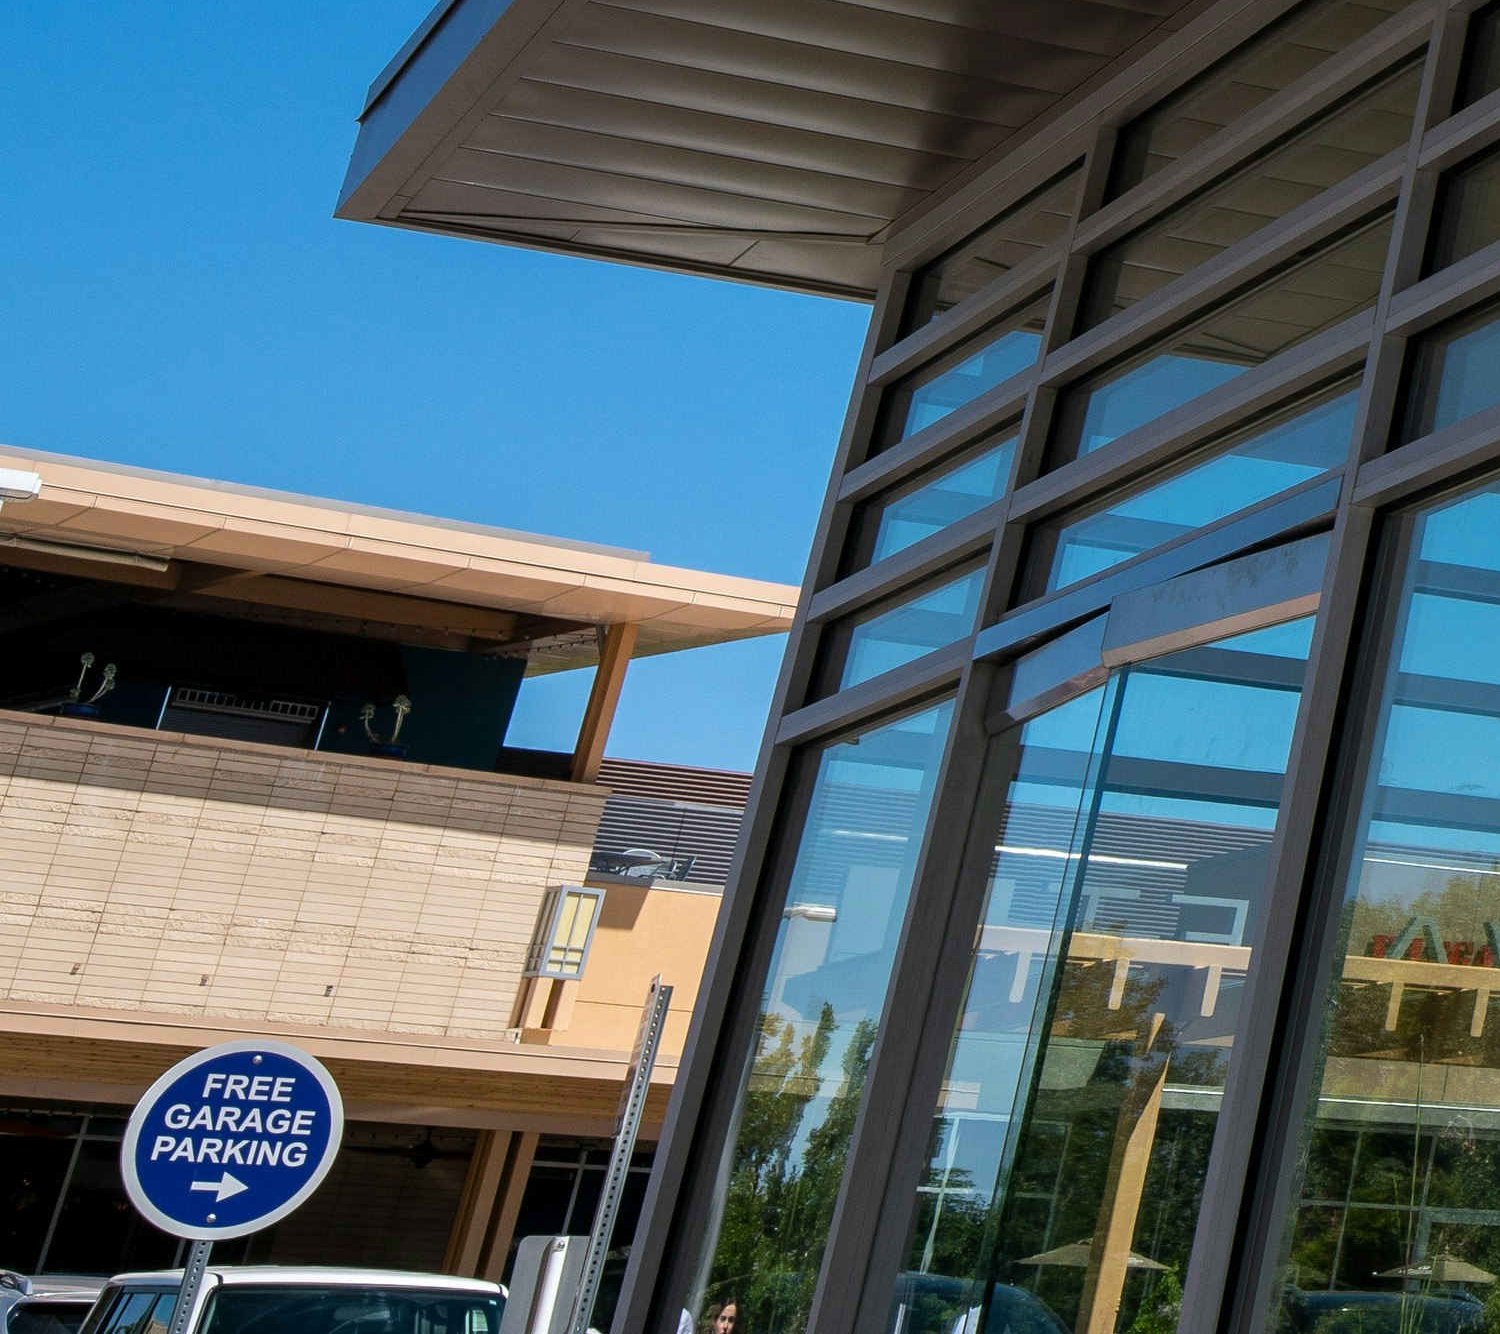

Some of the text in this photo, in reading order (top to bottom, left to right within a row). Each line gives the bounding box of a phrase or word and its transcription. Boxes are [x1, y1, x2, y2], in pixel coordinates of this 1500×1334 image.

[202, 1073, 297, 1102] FREE
[164, 1103, 316, 1136] GARAGE
[150, 1135, 309, 1168] PARKING
